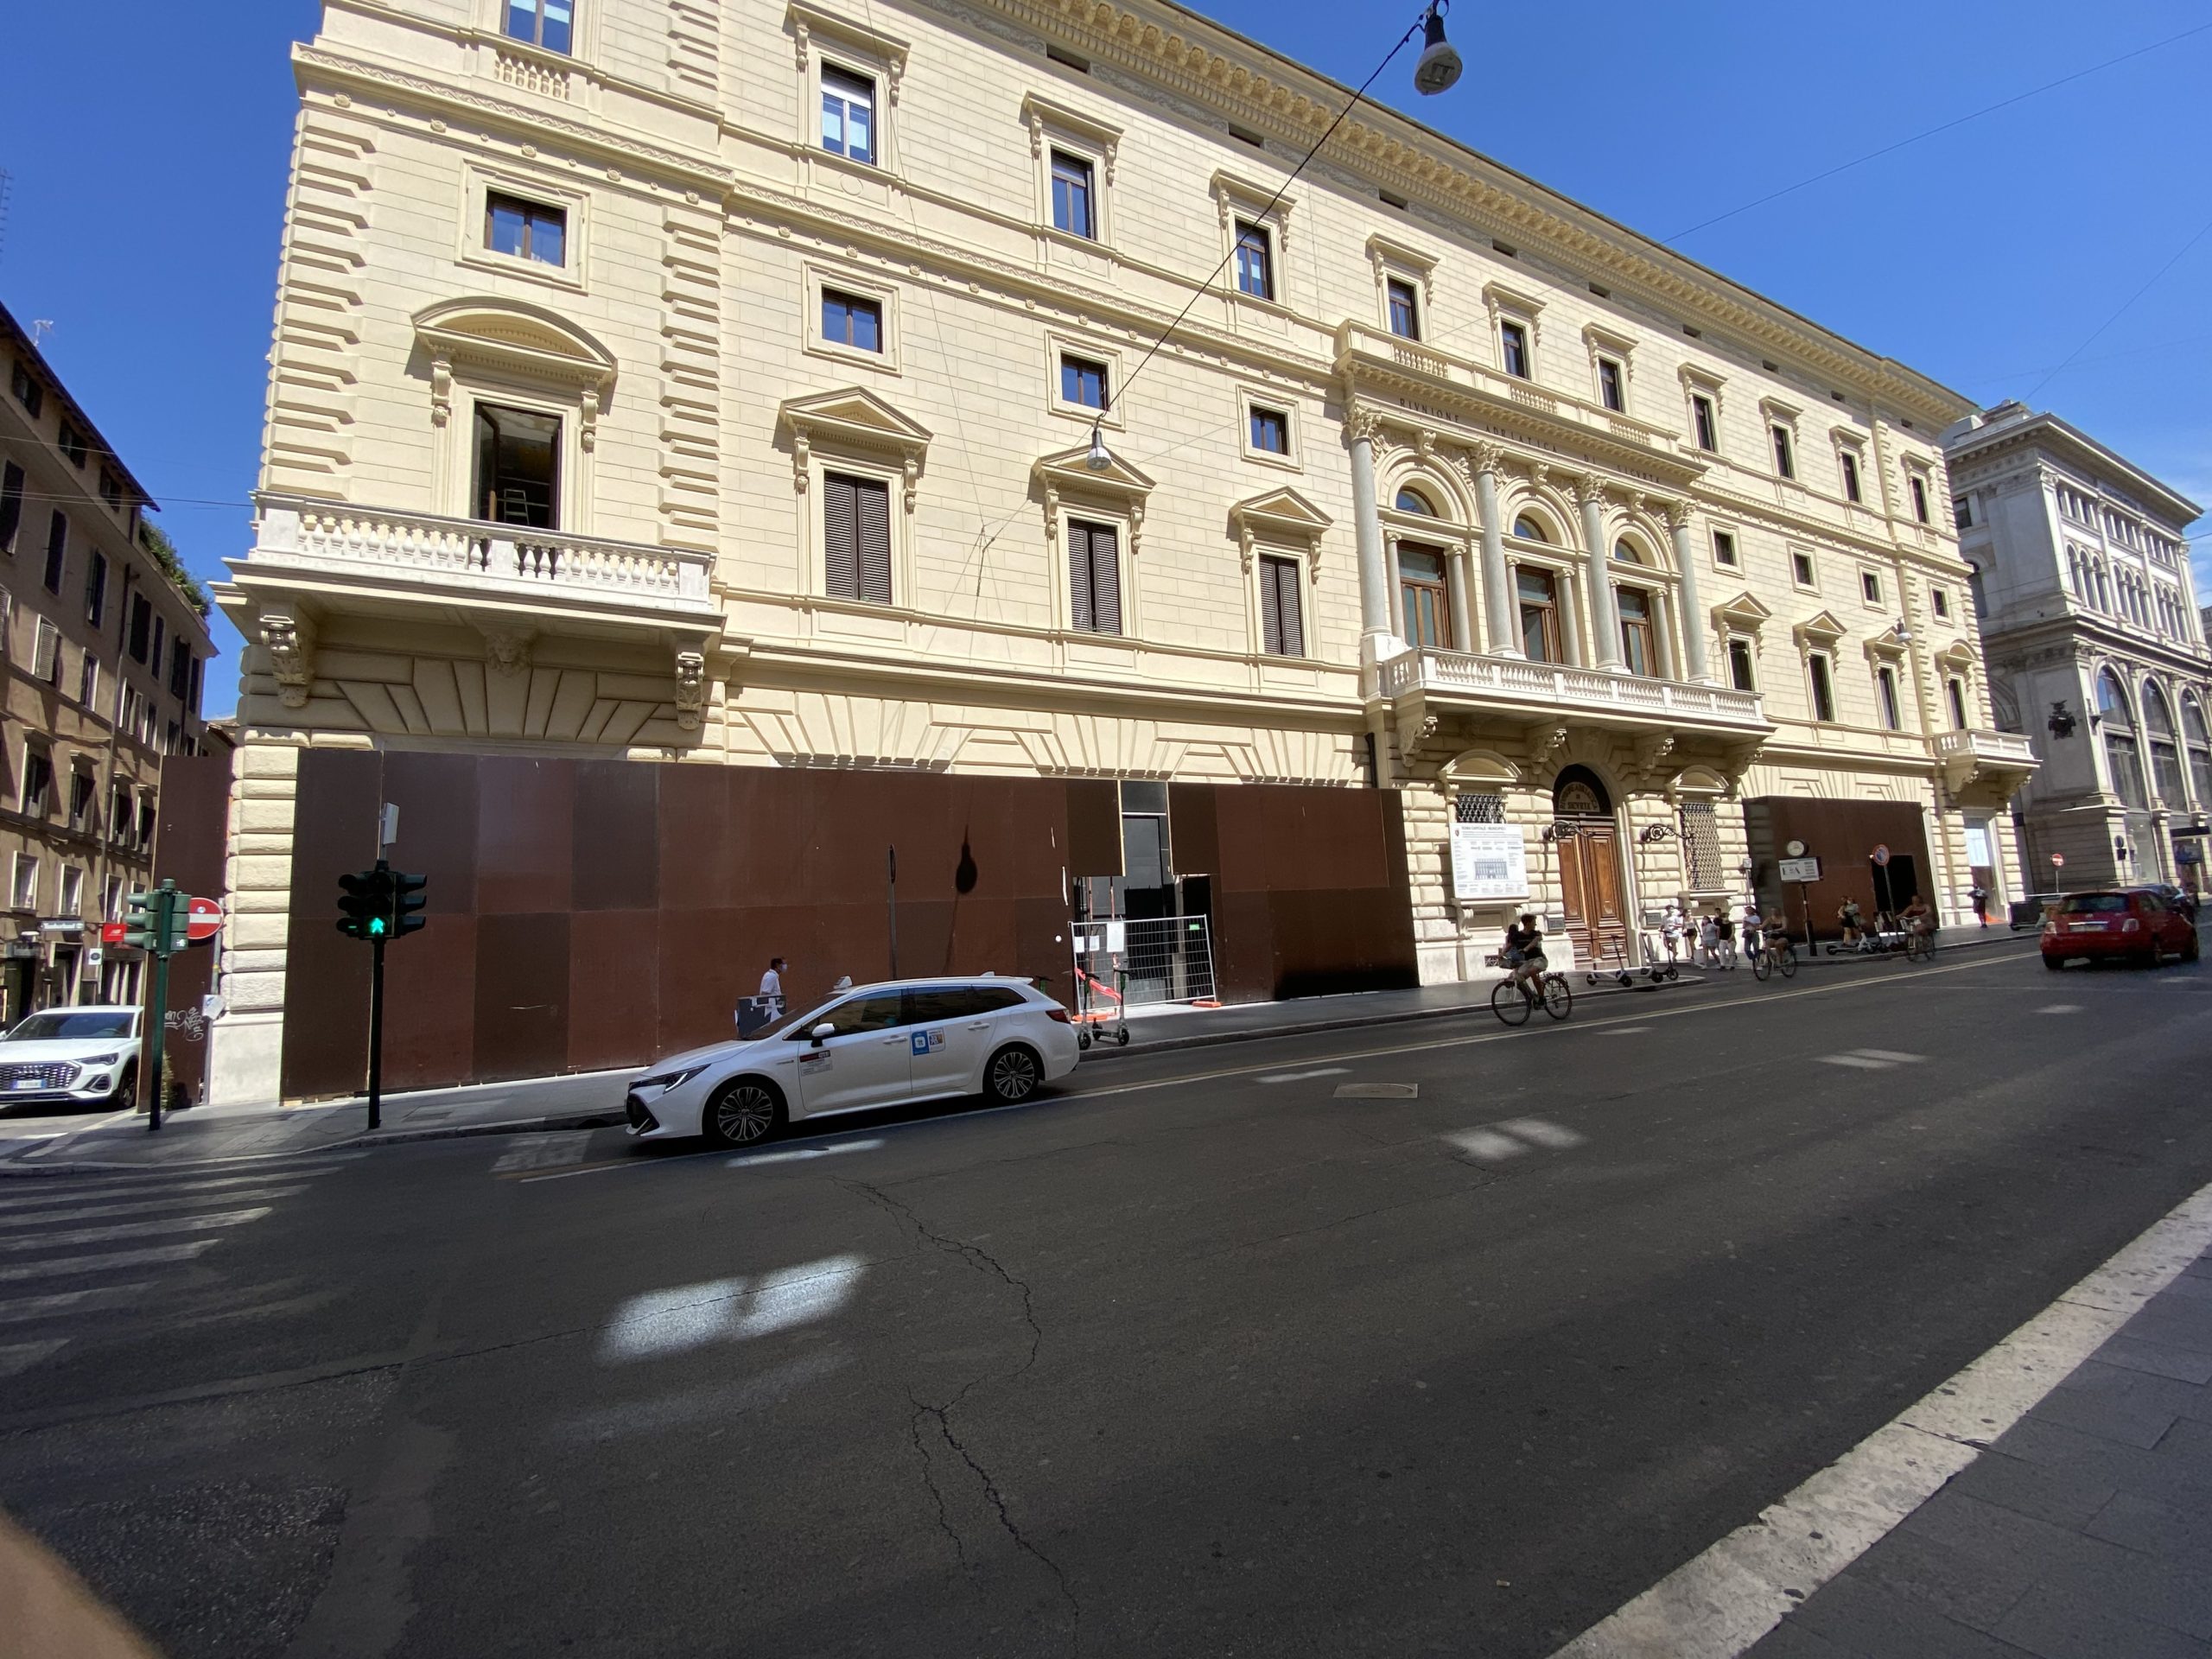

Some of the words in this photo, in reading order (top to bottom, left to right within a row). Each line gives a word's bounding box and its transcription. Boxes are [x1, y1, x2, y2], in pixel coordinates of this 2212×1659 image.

[1399, 397, 1459, 423] RIVNIONE
[1485, 424, 1557, 454] ADRIATICA
[1584, 454, 1596, 465] DI
